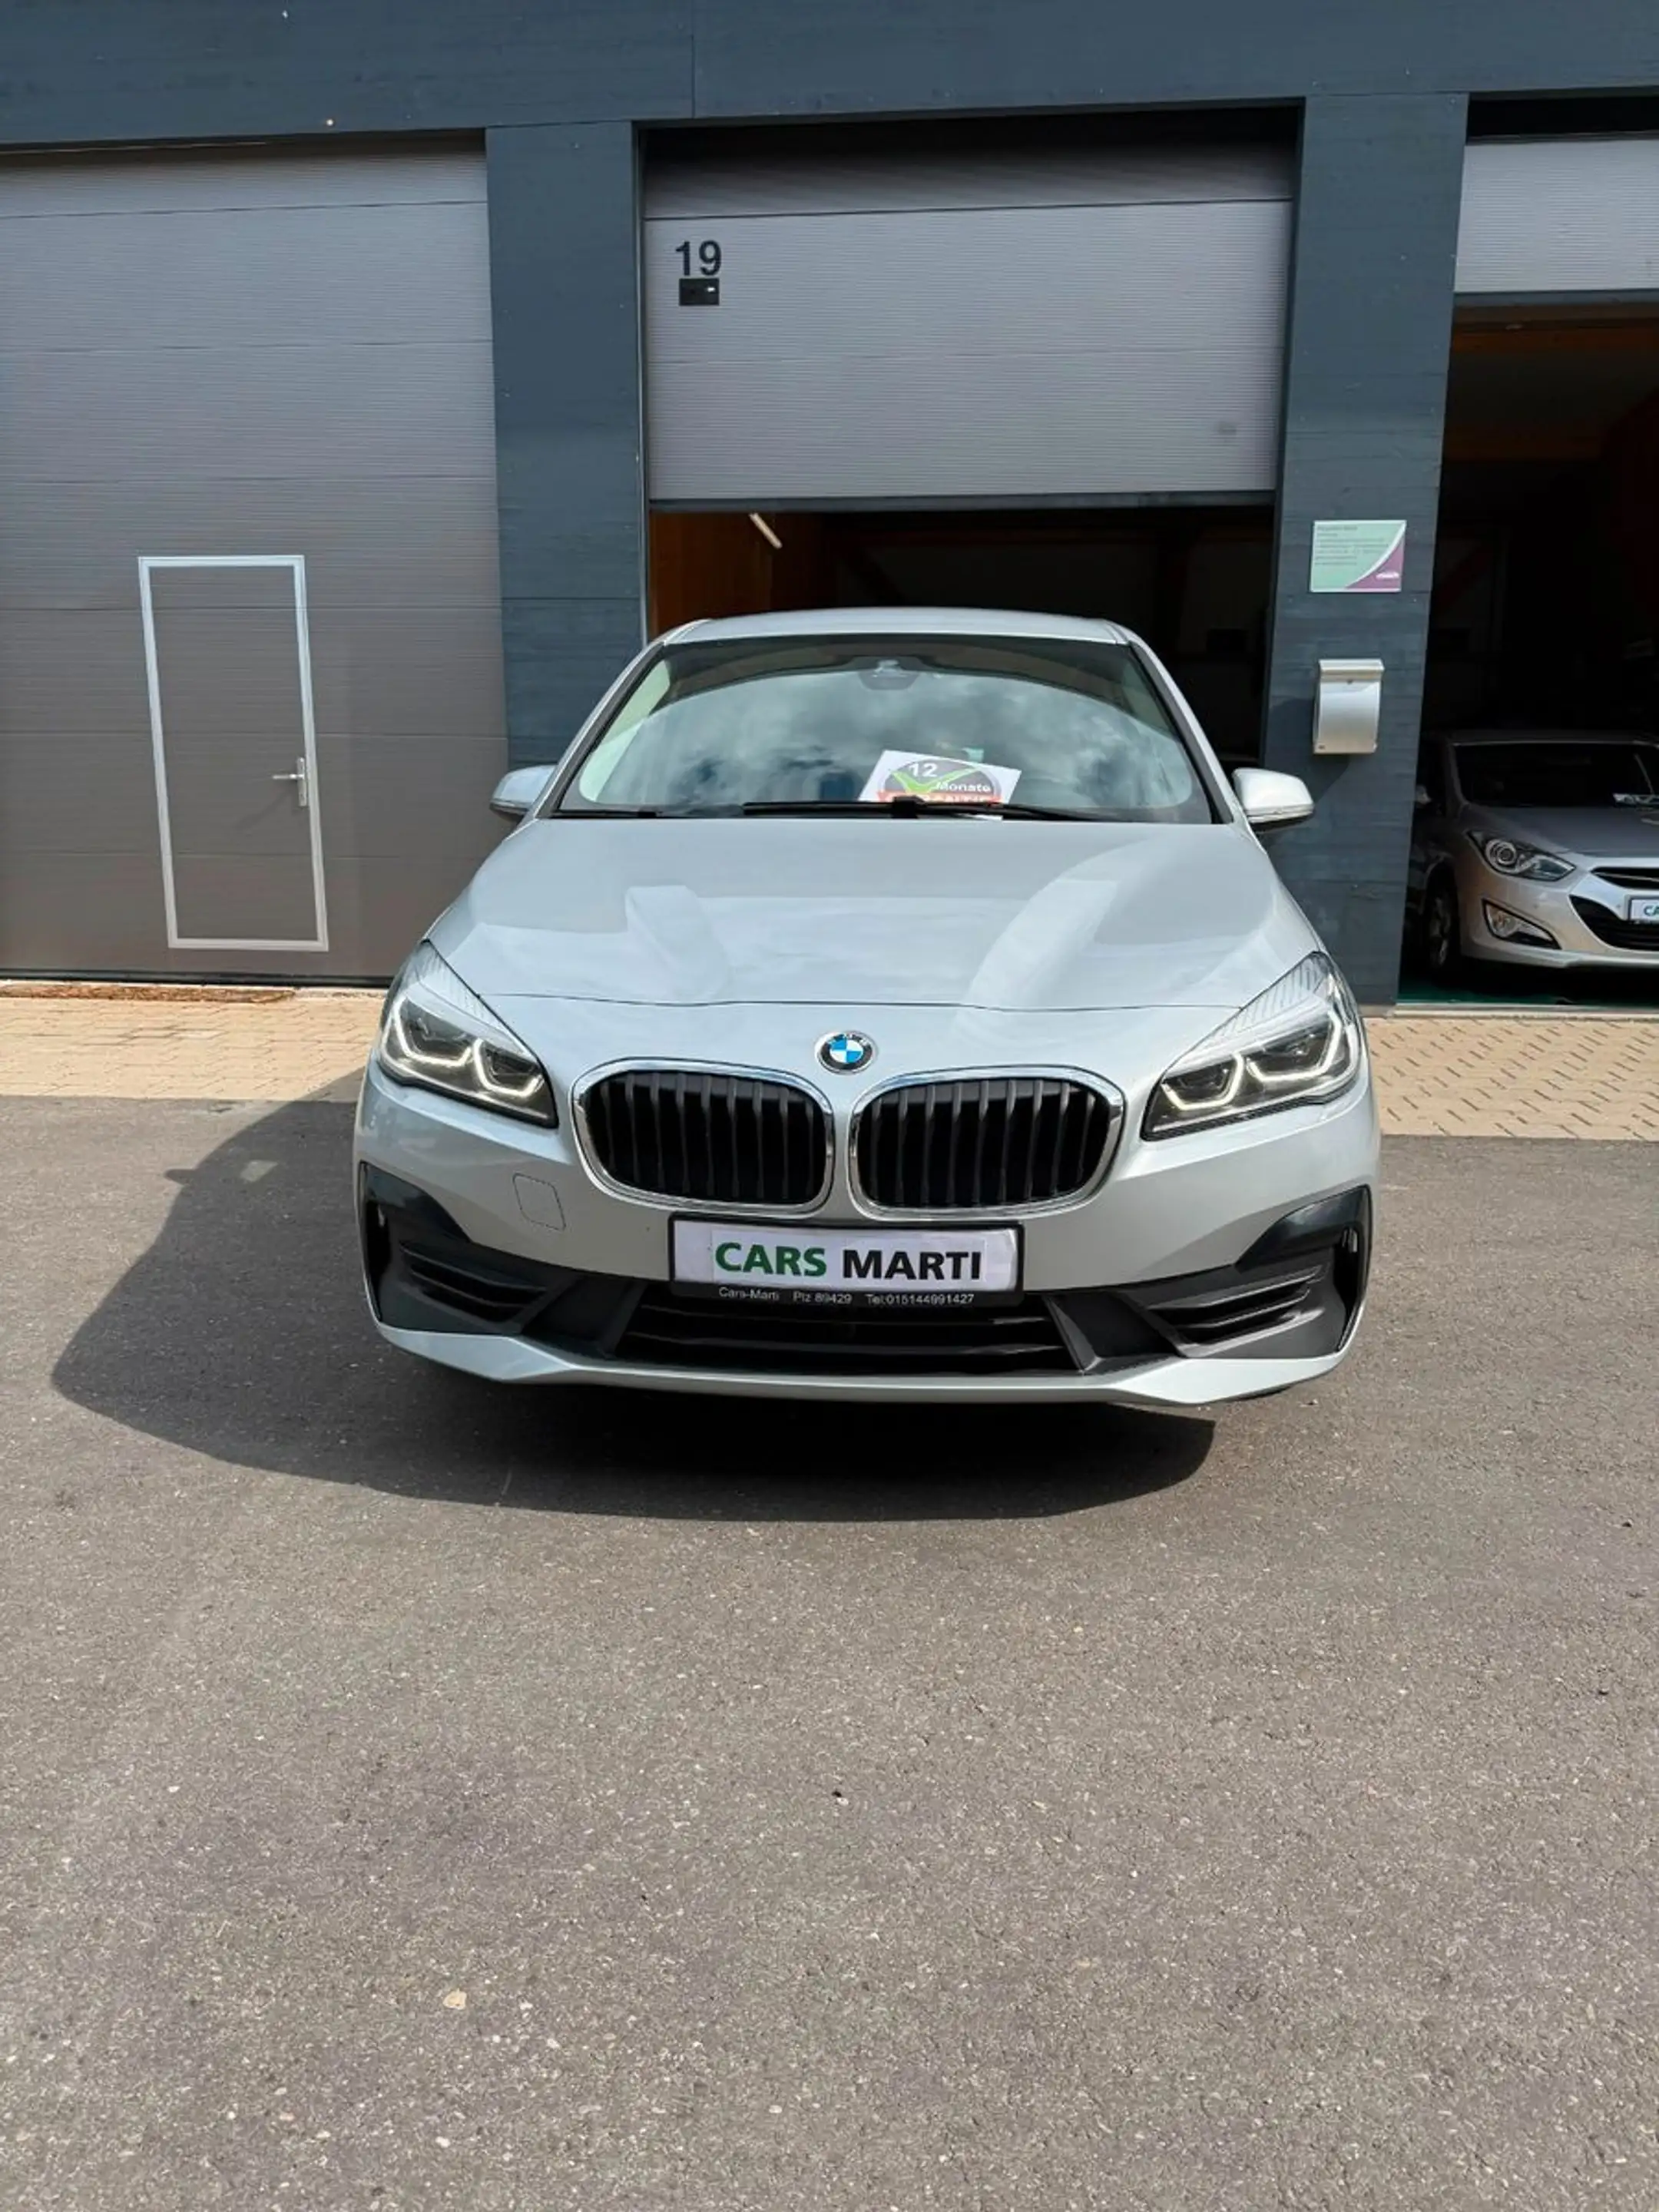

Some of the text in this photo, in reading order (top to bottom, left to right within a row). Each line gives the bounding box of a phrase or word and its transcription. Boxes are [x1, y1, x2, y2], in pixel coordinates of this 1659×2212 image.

[676, 240, 721, 276] 19
[909, 763, 938, 777] 12
[936, 780, 992, 793] Monate
[715, 1242, 981, 1280] CARS MARTI
[719, 1286, 780, 1300] Cars-Marti
